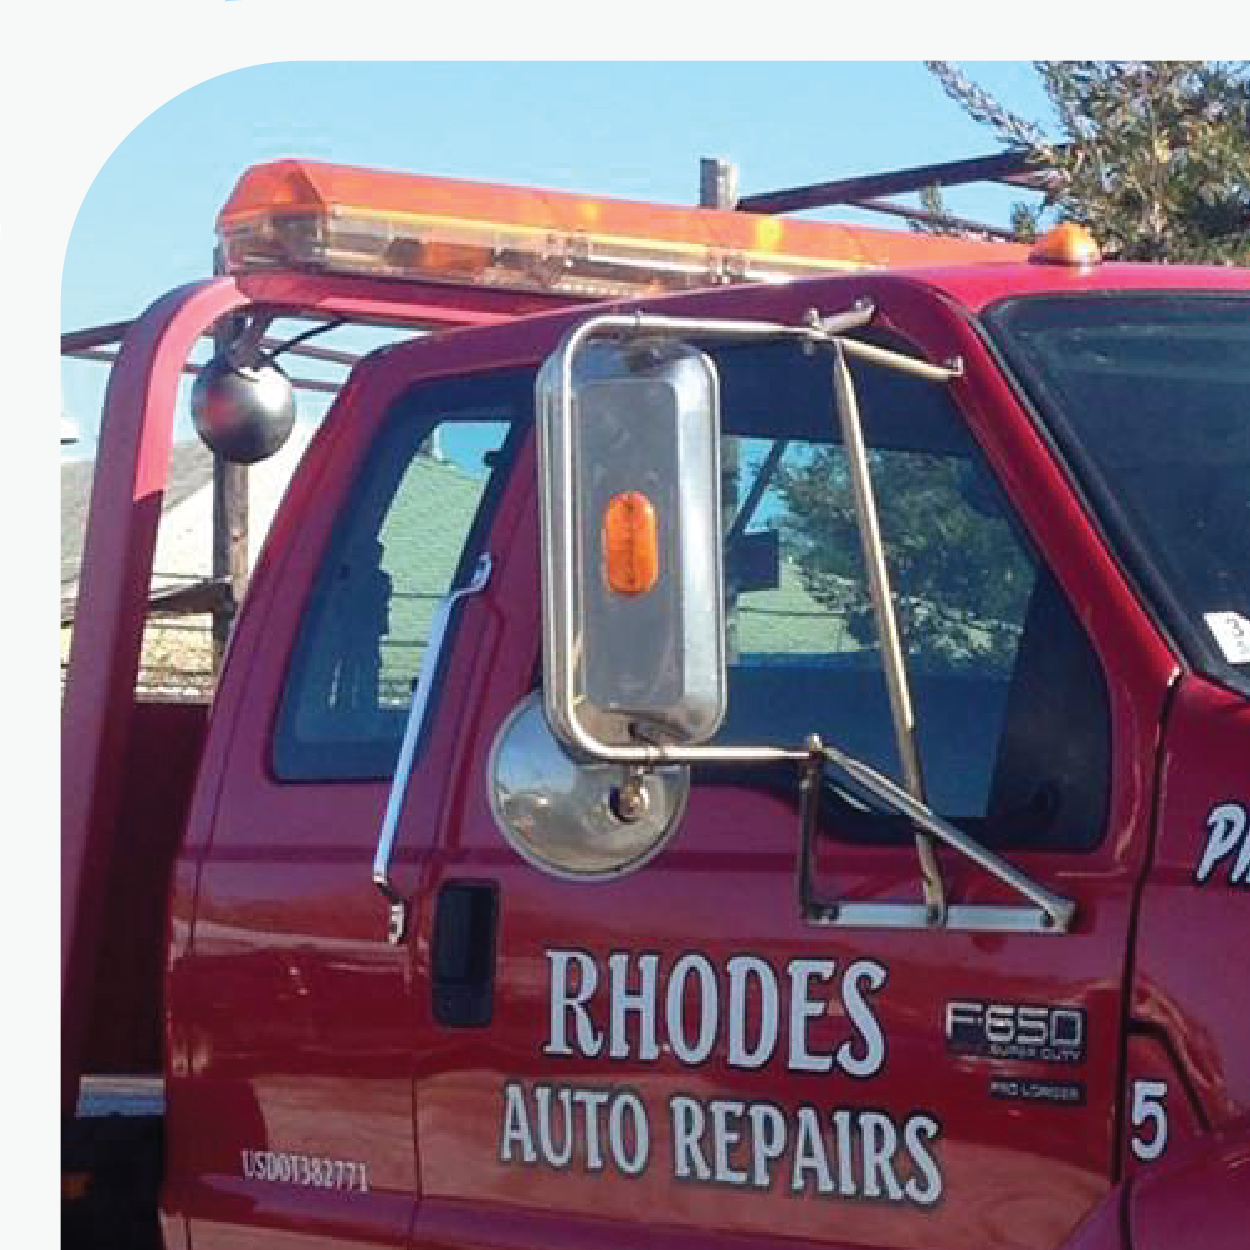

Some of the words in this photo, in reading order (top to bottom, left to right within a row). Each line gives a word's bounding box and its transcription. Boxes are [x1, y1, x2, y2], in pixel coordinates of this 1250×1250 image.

[543, 947, 888, 1078] RHODES
[500, 1082, 652, 1175] AUTO
[670, 1095, 943, 1206] REPAIRS
[1130, 1081, 1168, 1160] 5
